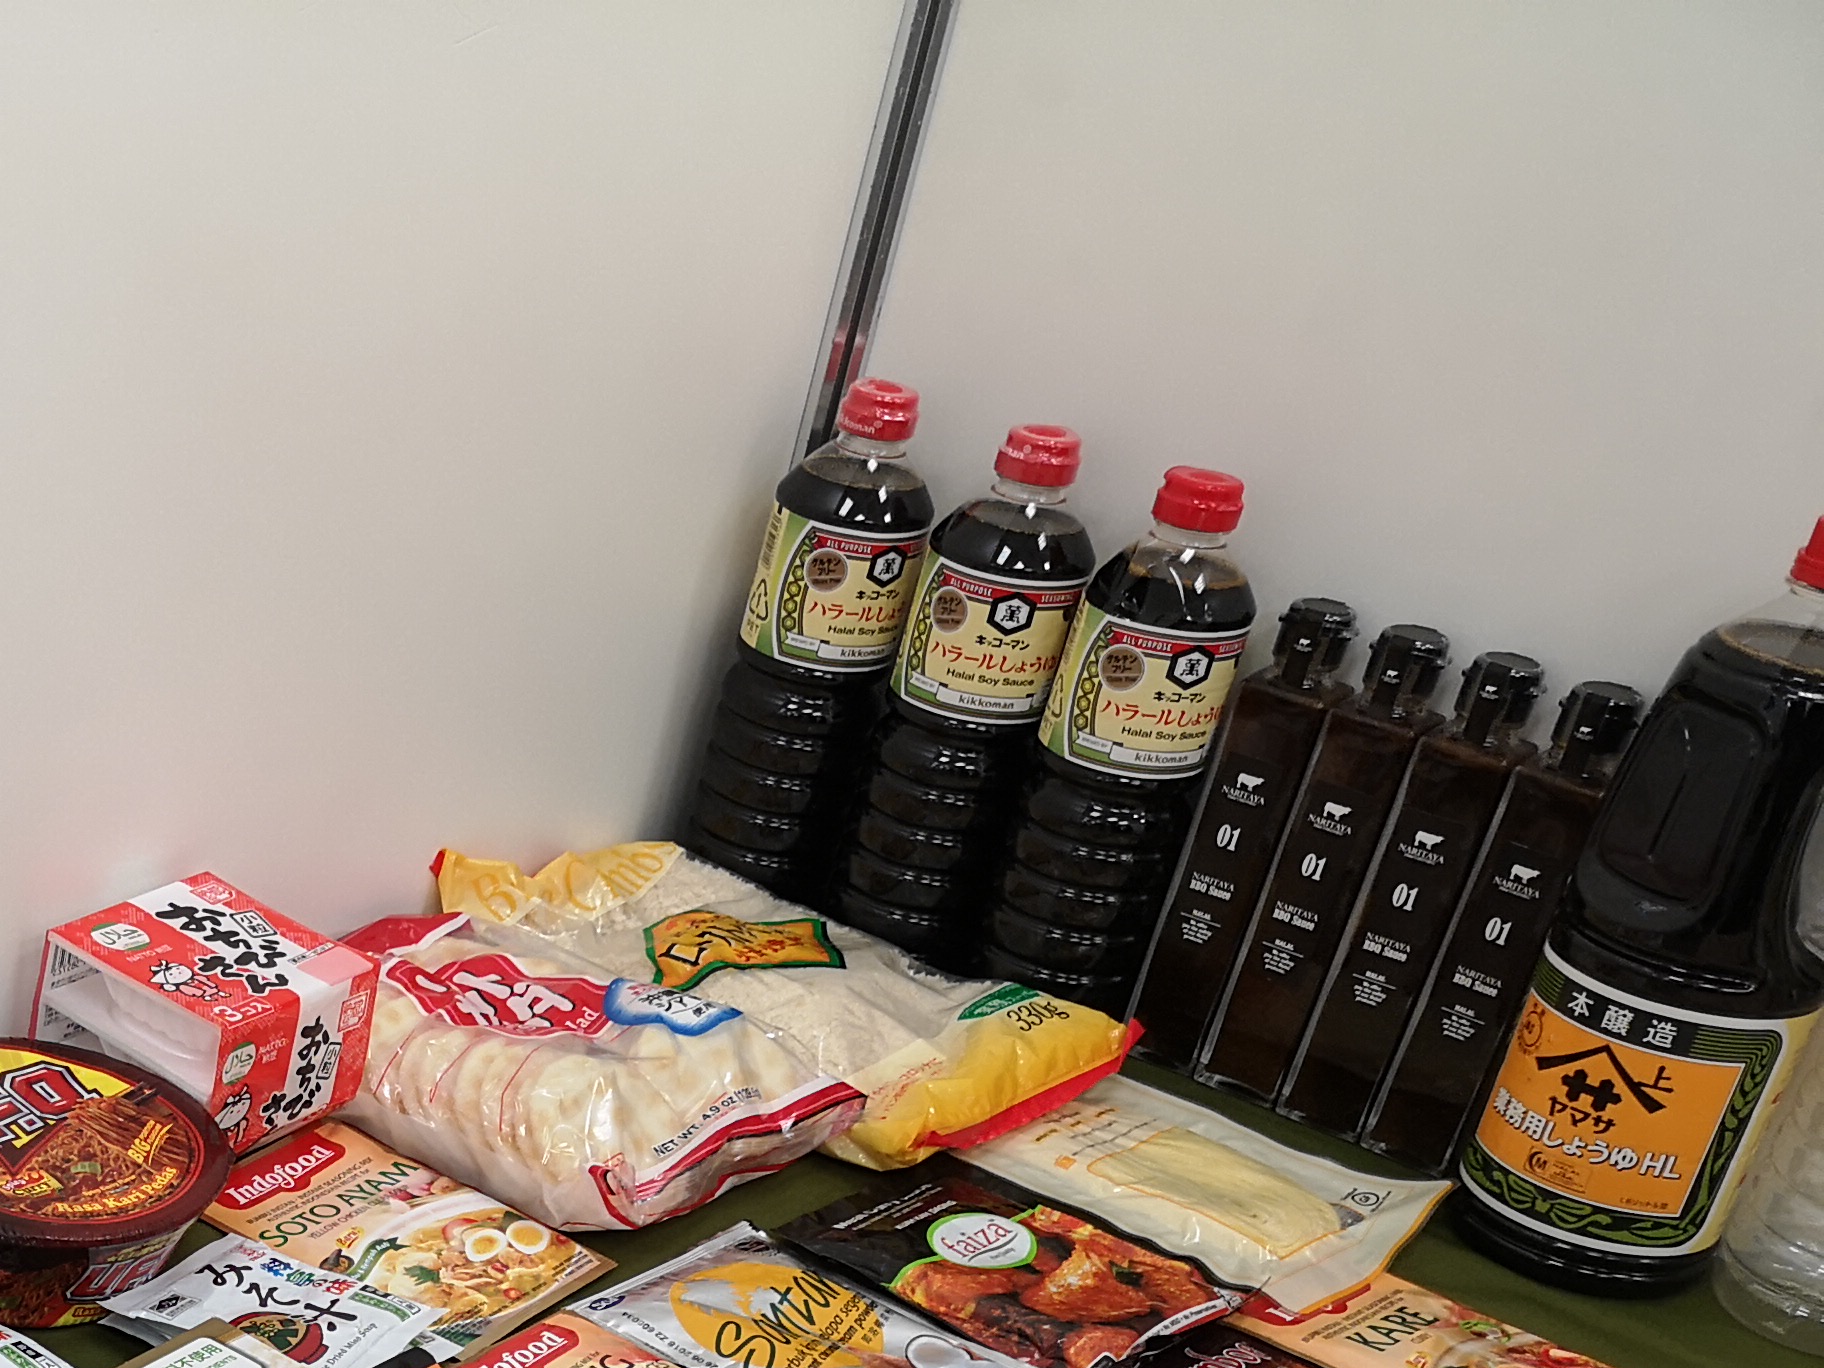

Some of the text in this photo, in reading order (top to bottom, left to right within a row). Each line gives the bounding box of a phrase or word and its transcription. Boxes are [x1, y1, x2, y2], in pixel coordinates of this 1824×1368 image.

[840, 541, 873, 554] PURPOSE
[965, 582, 993, 598] PURPOSE
[827, 624, 857, 636] Halal
[974, 634, 1031, 652] キッコーマン
[1137, 637, 1174, 654] PURPOSE
[945, 666, 1036, 689] Halal Soy Sauce
[957, 692, 1016, 711] kikkoman
[1152, 690, 1208, 705] キッコーマン
[1120, 725, 1209, 744] Halal Soy Sauce
[1133, 751, 1190, 766] kikkoman
[1221, 783, 1265, 806] NARITAYA
[1307, 811, 1353, 836] NARITAYA
[1215, 823, 1242, 852] 01
[1397, 841, 1446, 866] NARITAYA
[1300, 852, 1327, 882] 01
[1188, 878, 1209, 896] BBQ
[1190, 870, 1236, 893] NARITAYA
[1491, 874, 1541, 900] NARITAYA
[1391, 882, 1420, 912] 01
[1271, 907, 1292, 924] BBQ
[1274, 900, 1319, 924] NARITAYA
[1364, 930, 1412, 954] NARITAYA
[1483, 916, 1513, 947] 01
[1361, 938, 1384, 954] BBQ
[1451, 971, 1474, 988] BBQ
[1455, 964, 1504, 989] NARITAYA
[1006, 998, 1070, 1032] 330g
[1566, 991, 1679, 1049] 本醸造
[1491, 1086, 1640, 1170] 業務用しょうゆ
[1548, 1096, 1617, 1135] ヤマサ
[653, 1138, 678, 1158] NET
[677, 1123, 704, 1146] WT.
[224, 1143, 336, 1206] Indofood
[55, 1165, 178, 1216] Rasa Kari Pedas
[257, 1203, 341, 1248] SOTO
[334, 1160, 421, 1207] AYAM
[940, 1217, 1015, 1258] faiza
[259, 1255, 360, 1297] 料亭の味
[193, 1259, 364, 1335] みそ汁
[1344, 1305, 1441, 1352] KARE
[326, 1345, 349, 1368] Dried
